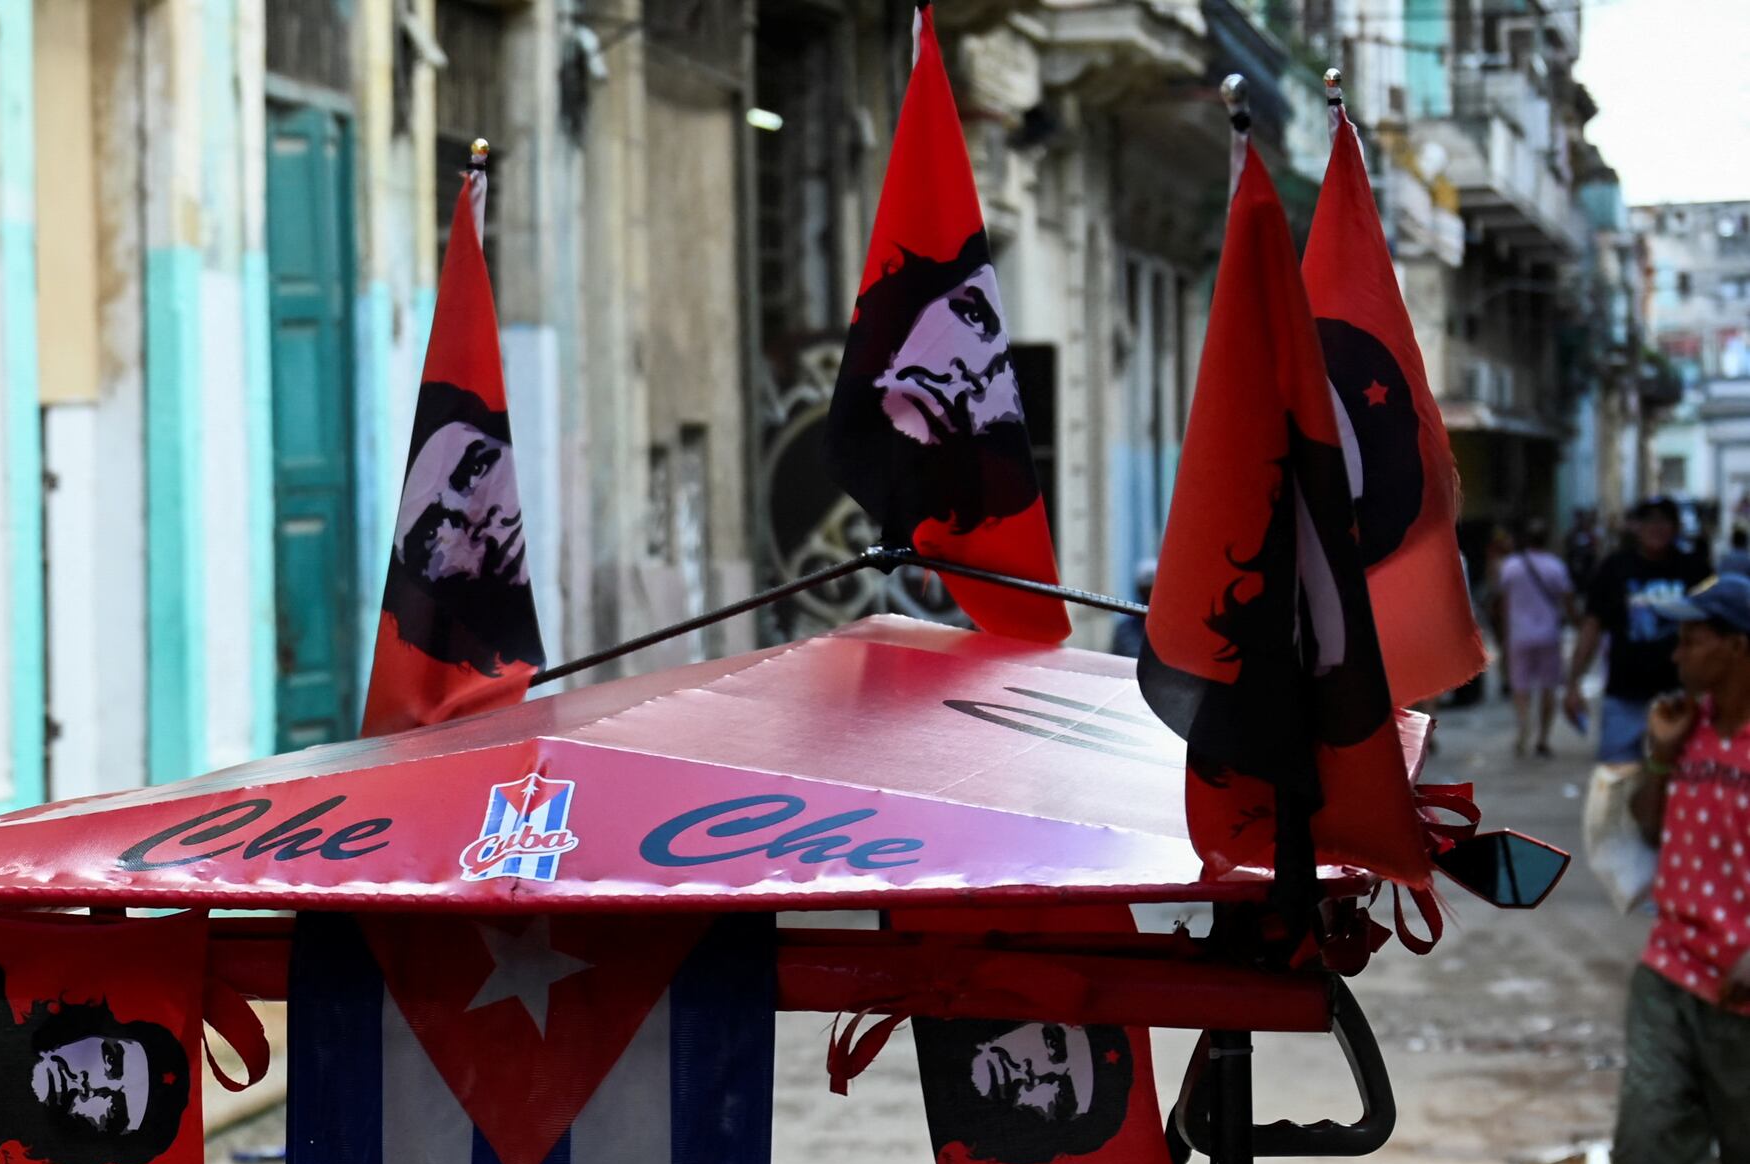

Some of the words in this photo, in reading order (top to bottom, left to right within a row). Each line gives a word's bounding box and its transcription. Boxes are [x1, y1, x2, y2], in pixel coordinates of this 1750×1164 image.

[116, 795, 392, 872] Che
[461, 824, 576, 876] Cuba
[639, 794, 924, 869] Che
